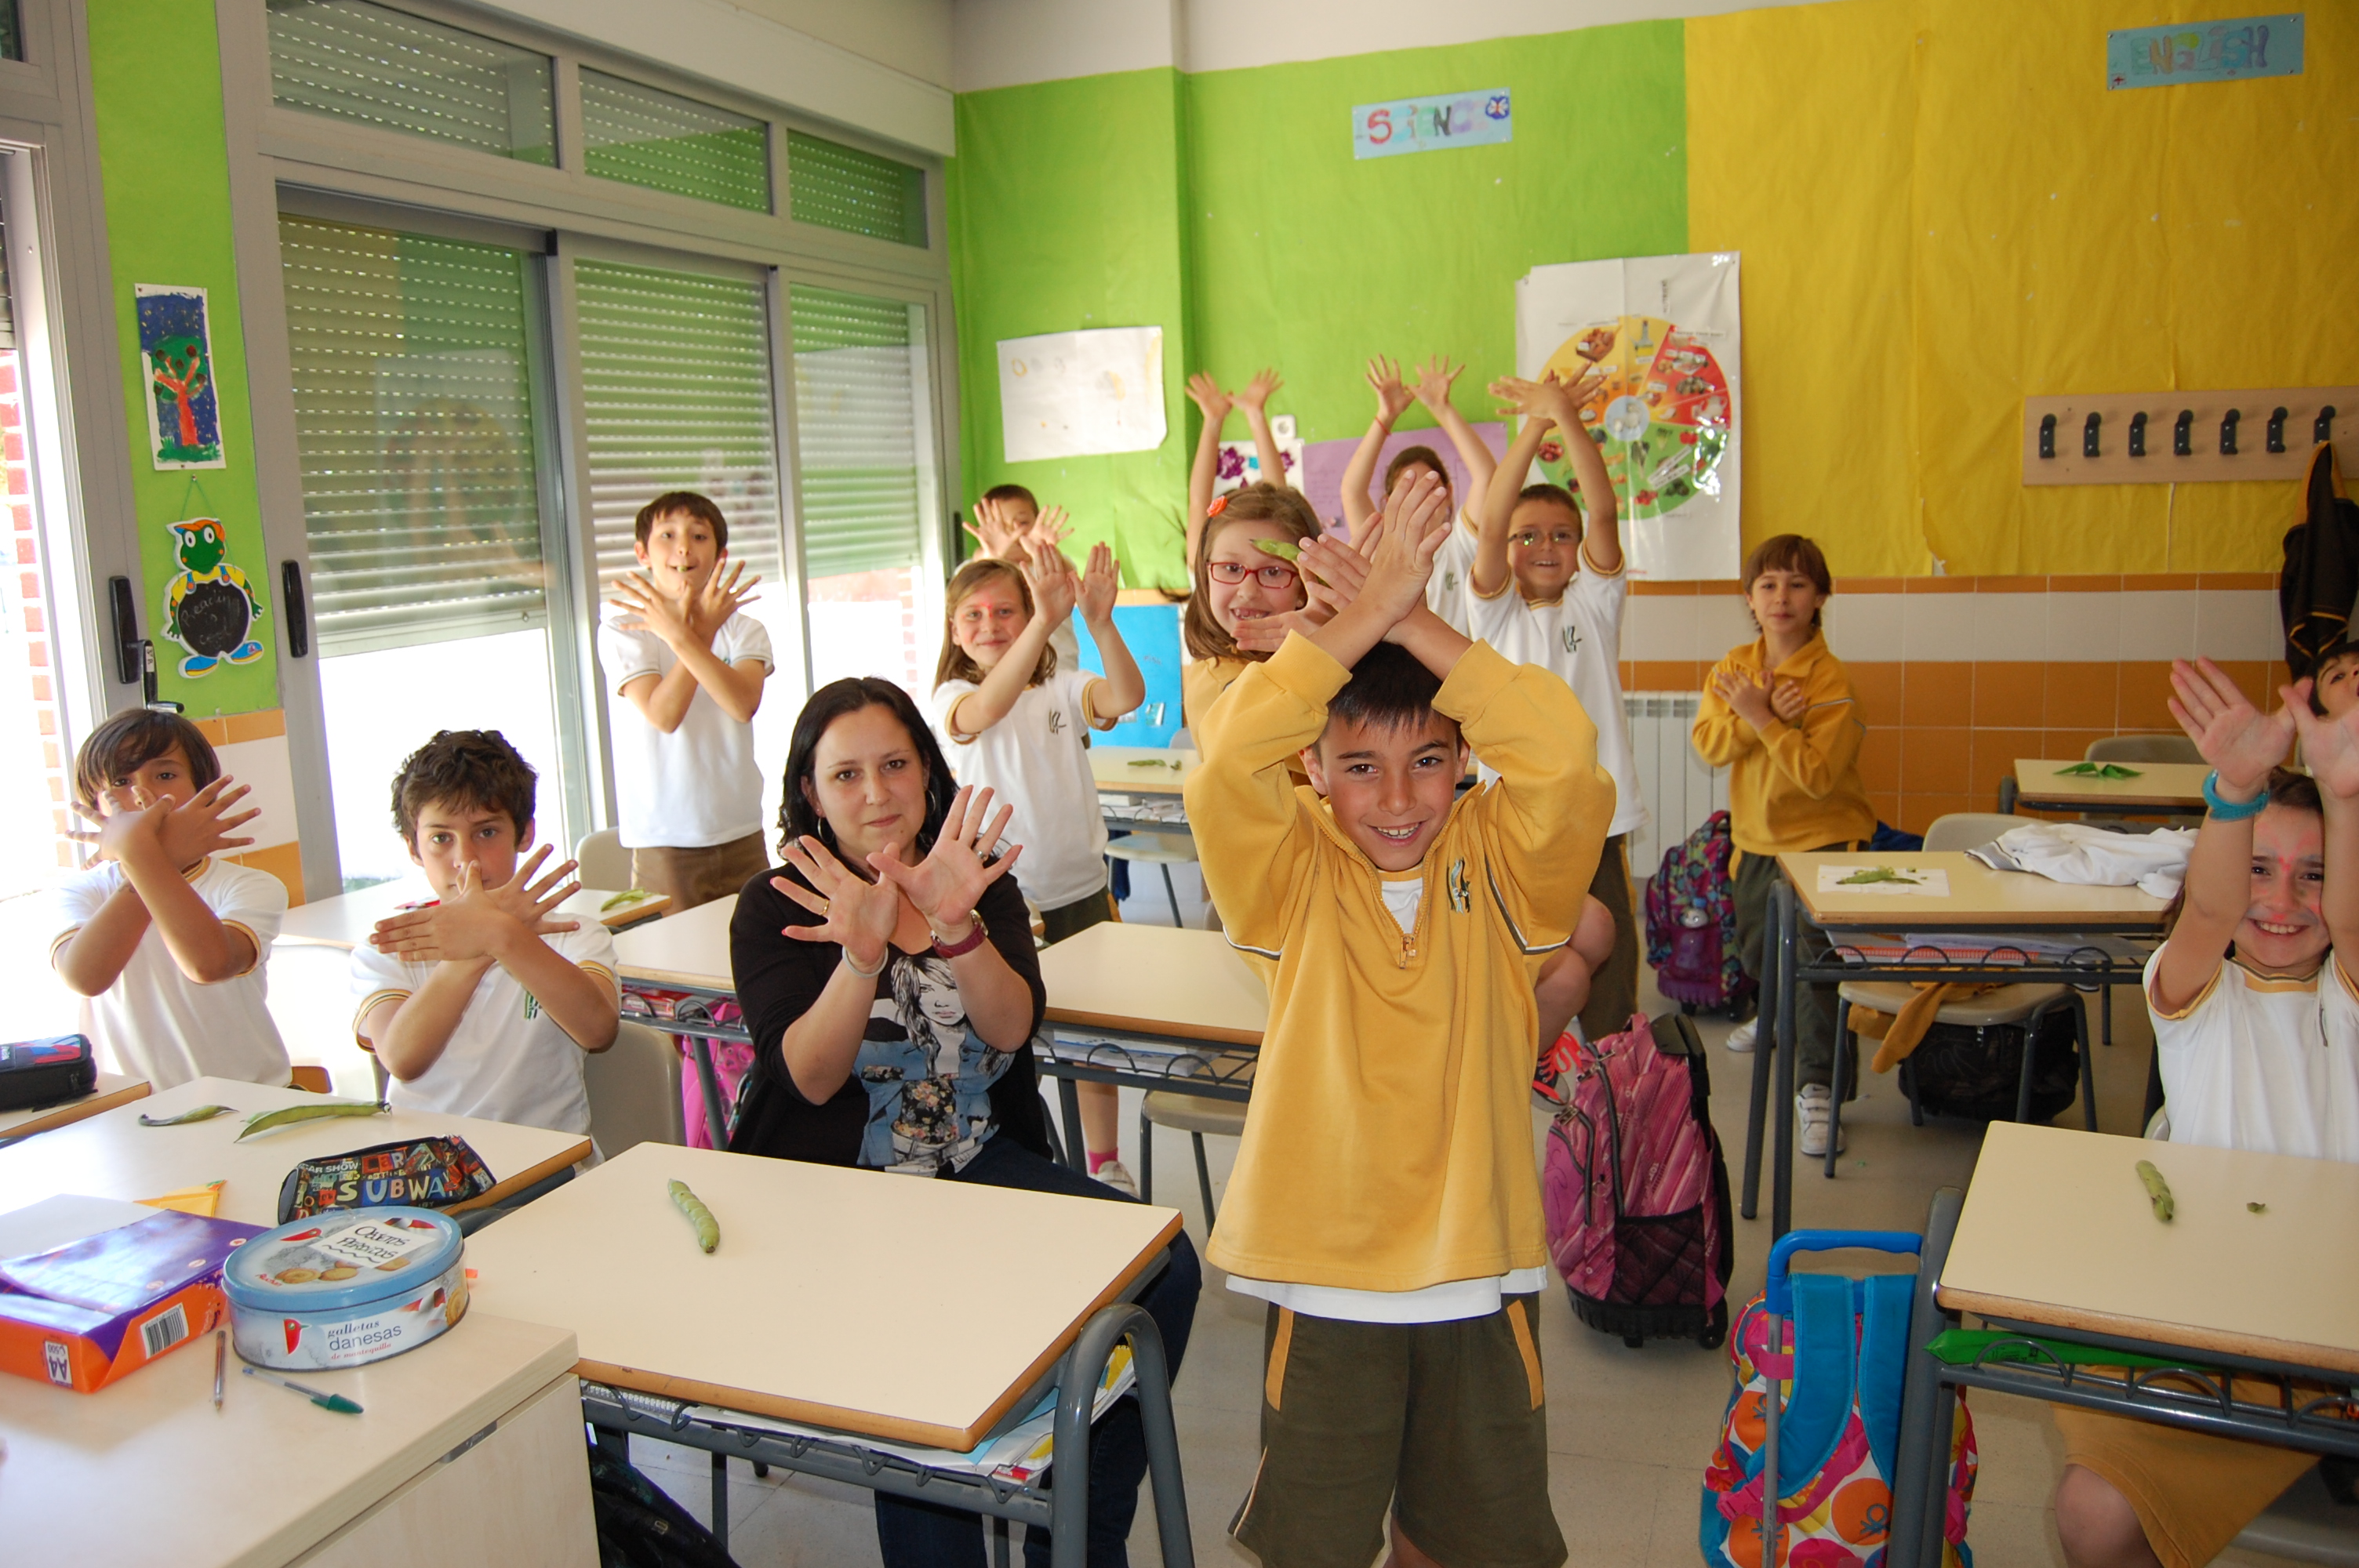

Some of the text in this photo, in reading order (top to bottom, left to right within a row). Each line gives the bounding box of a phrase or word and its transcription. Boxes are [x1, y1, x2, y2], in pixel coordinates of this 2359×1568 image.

[325, 1161, 358, 1173] SHOW
[328, 1320, 380, 1339] galletas
[329, 1325, 402, 1351] danesas
[49, 1356, 68, 1381] A4
